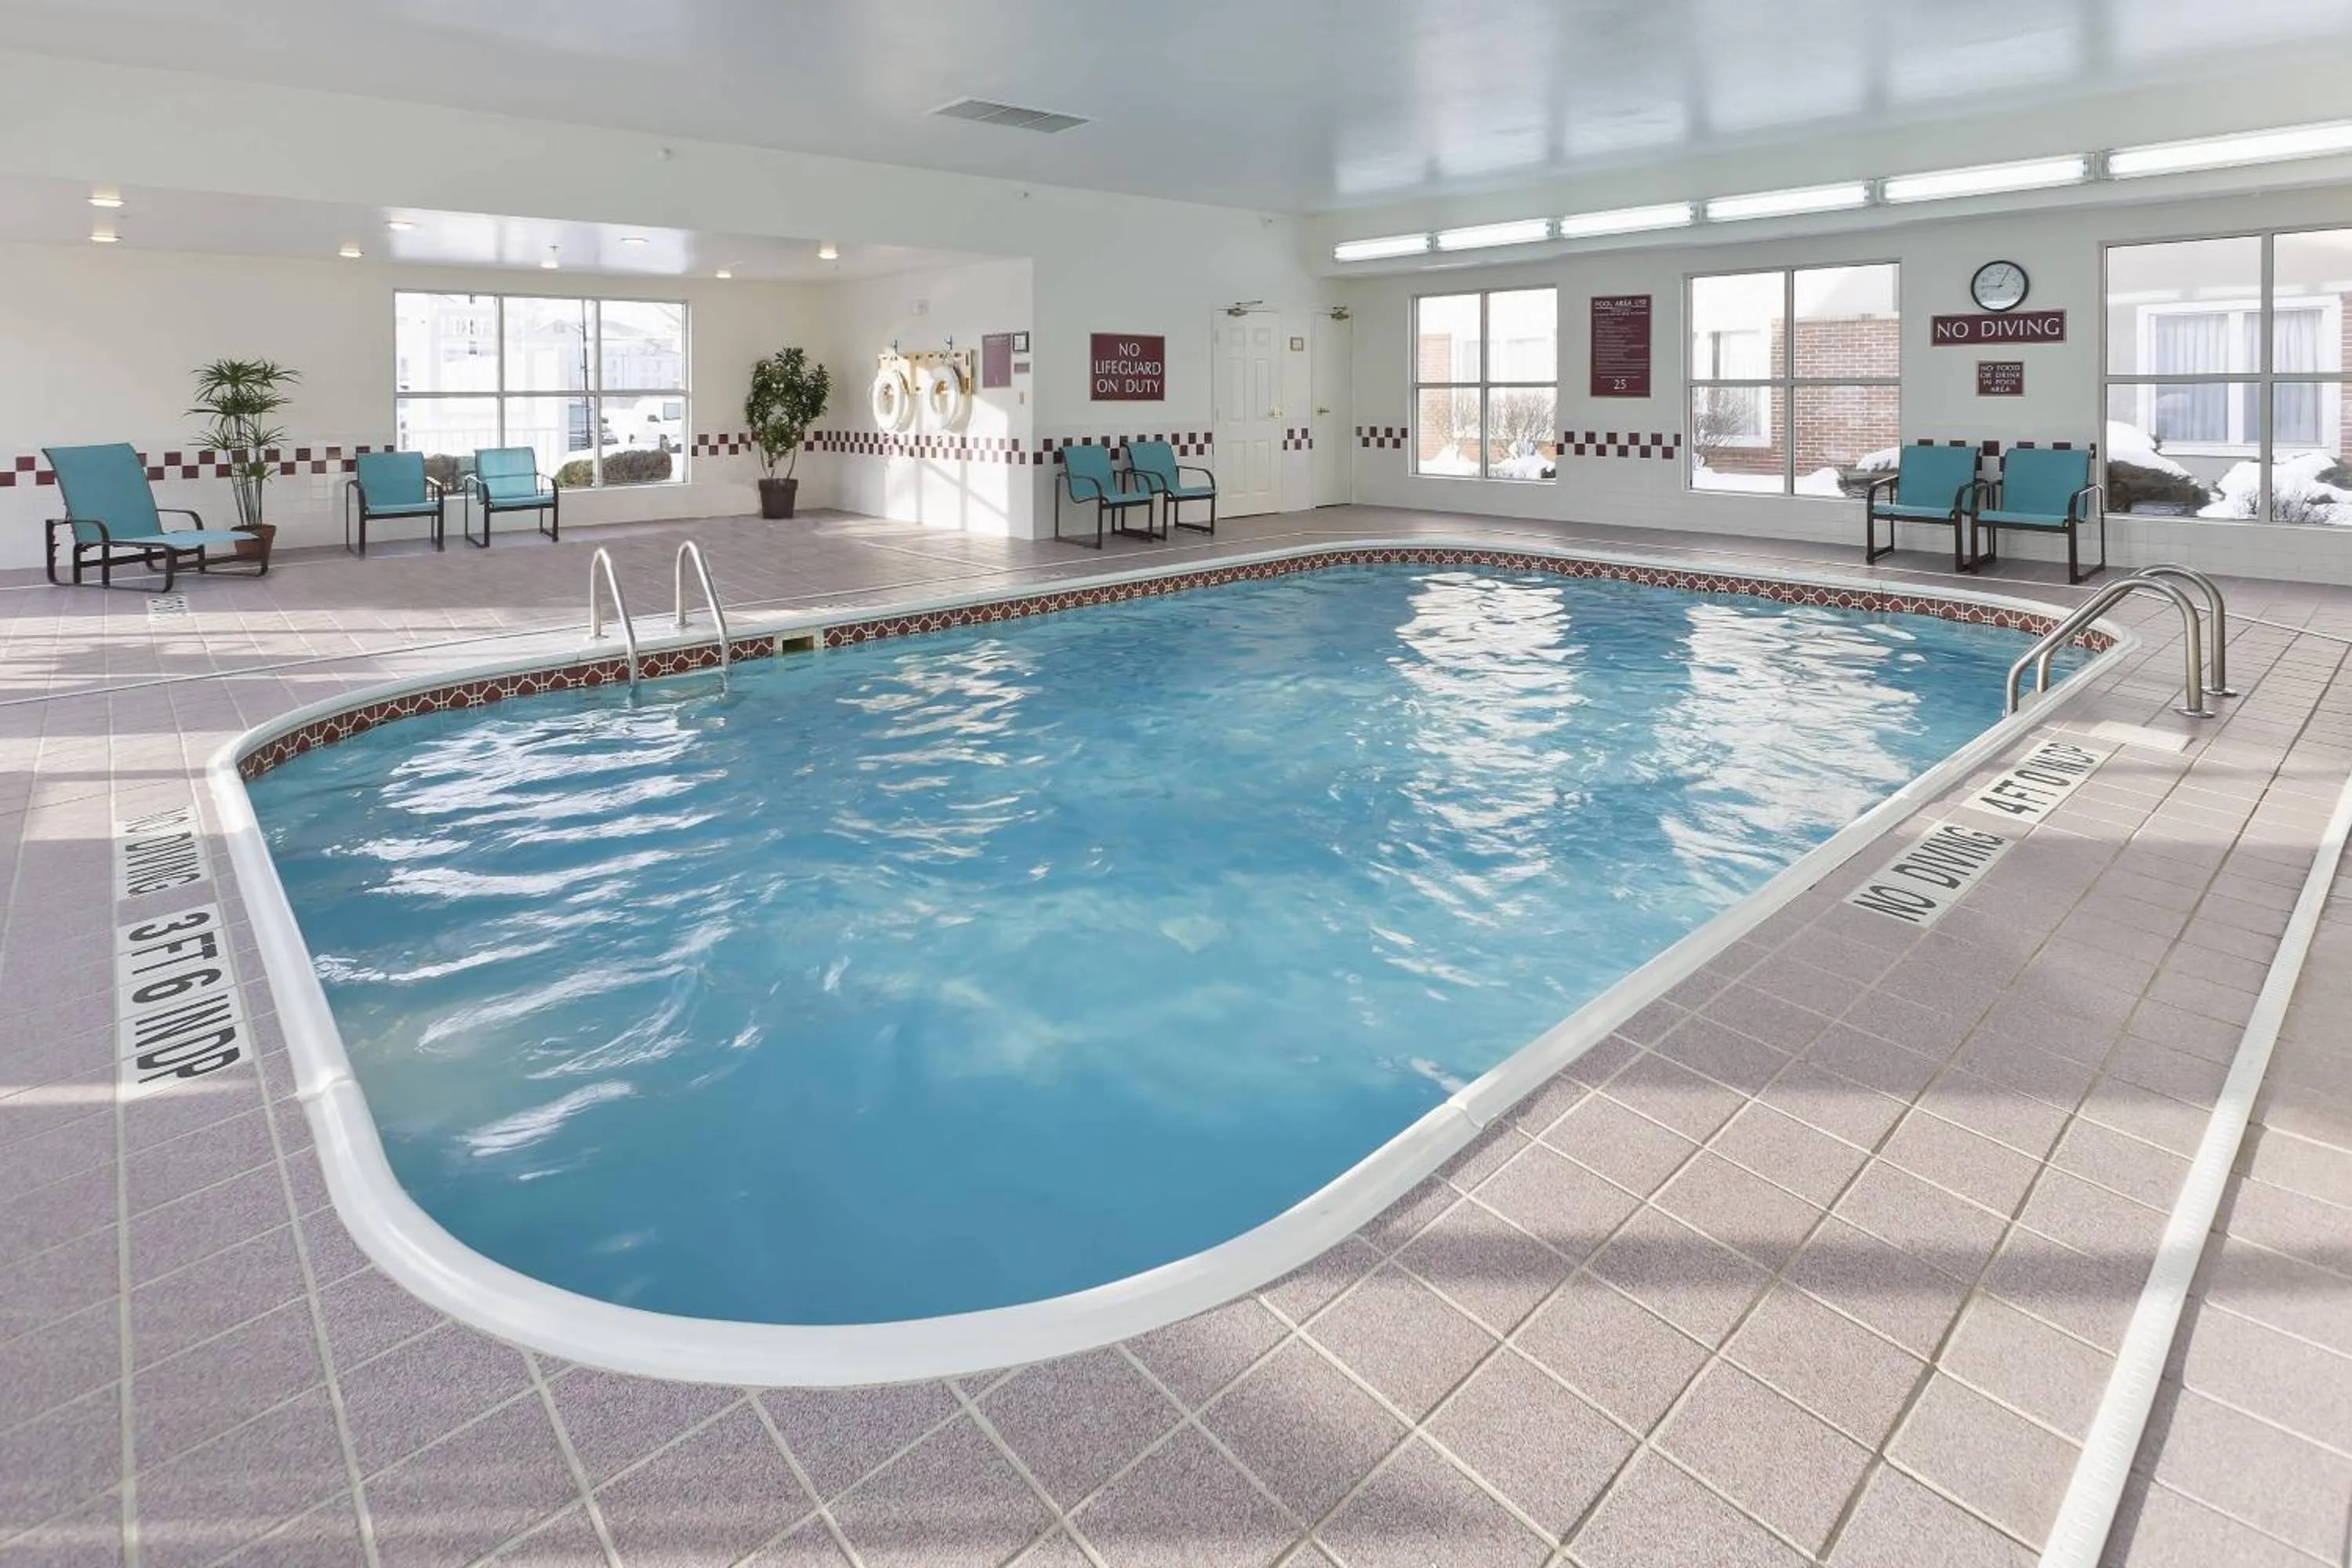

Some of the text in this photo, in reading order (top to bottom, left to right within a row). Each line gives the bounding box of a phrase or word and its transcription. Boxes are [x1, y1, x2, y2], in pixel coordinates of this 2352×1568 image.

[1937, 318, 2060, 338] NO DIVING
[1118, 343, 1141, 358] NO
[1094, 359, 1162, 376] LIFEGUARD
[1097, 379, 1160, 393] ON DUTY
[1613, 379, 1627, 390] 25
[125, 831, 201, 895] DIVING
[1853, 826, 2006, 923] NO DIVING
